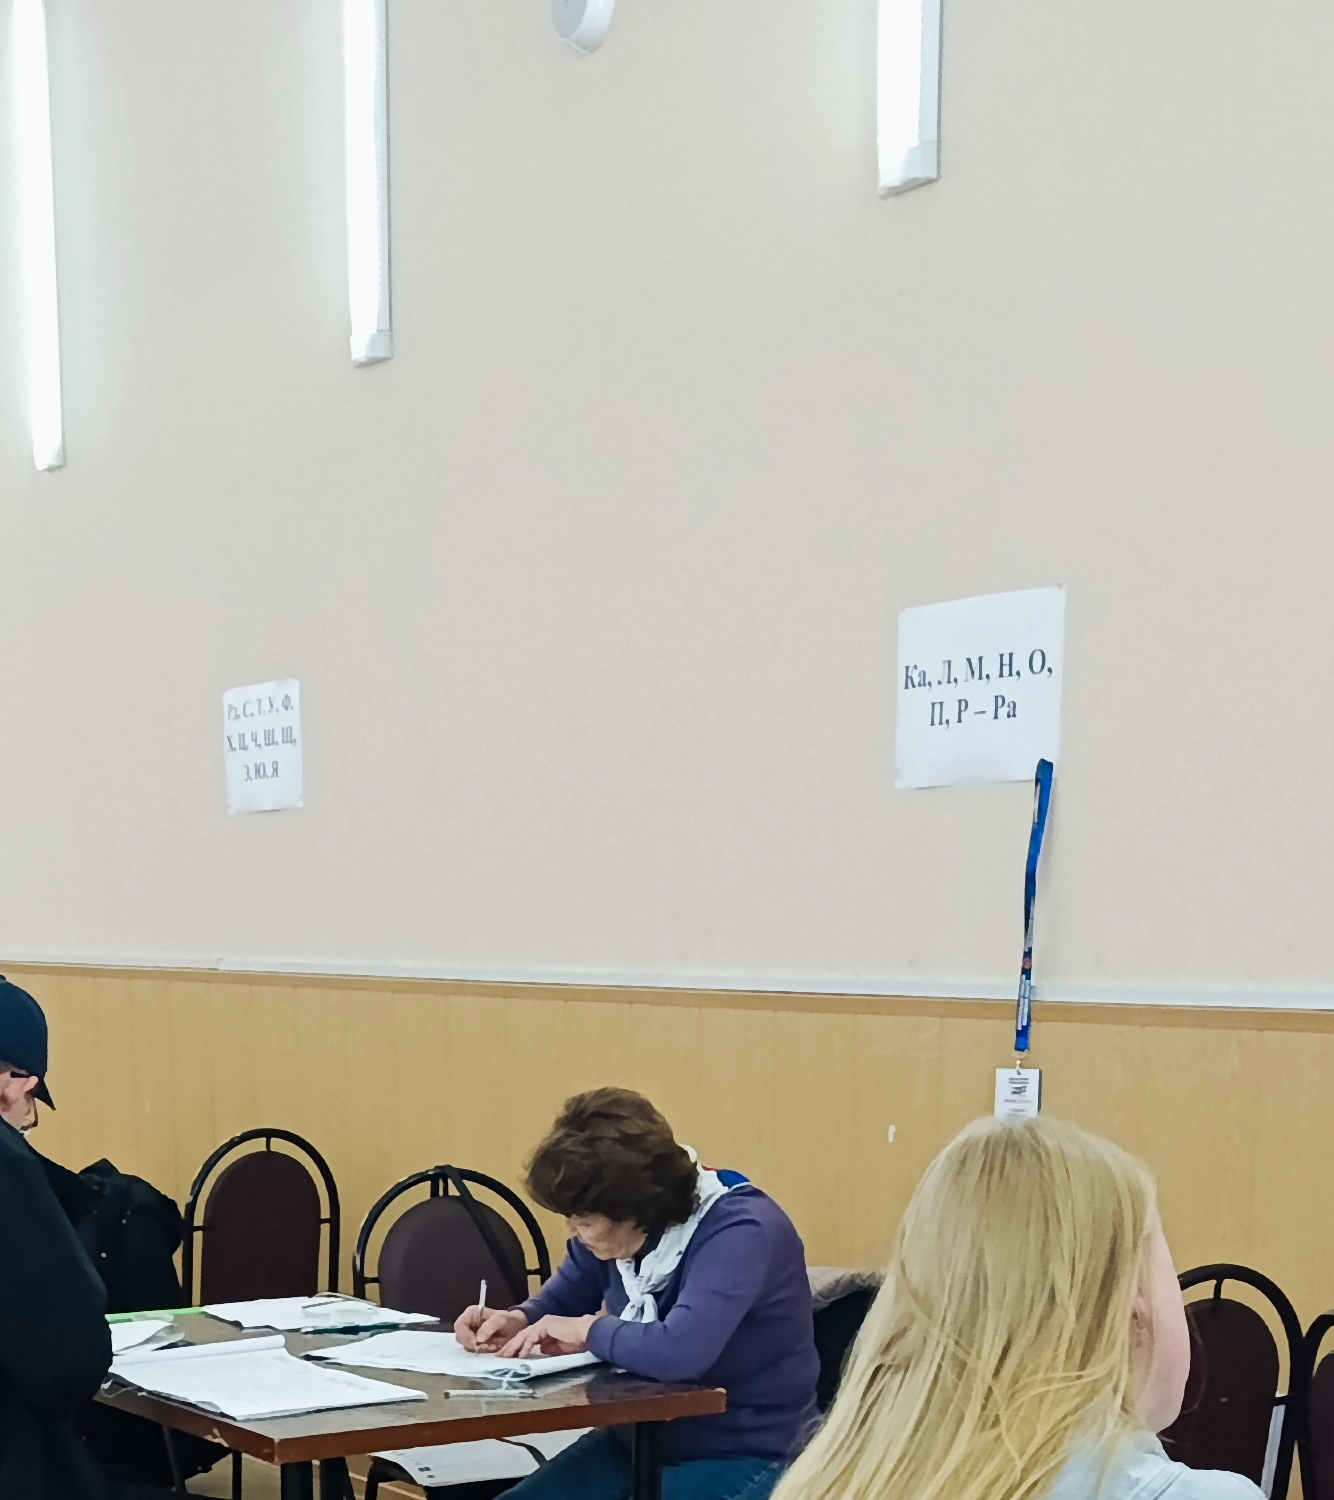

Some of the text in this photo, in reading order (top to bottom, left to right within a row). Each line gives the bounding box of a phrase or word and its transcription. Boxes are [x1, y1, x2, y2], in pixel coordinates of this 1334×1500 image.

[904, 648, 1053, 692] Ка, Л, М, Н, О,
[929, 701, 950, 730] П,
[956, 698, 969, 723] Р
[992, 695, 1017, 720] Ра
[270, 760, 279, 779] Я
